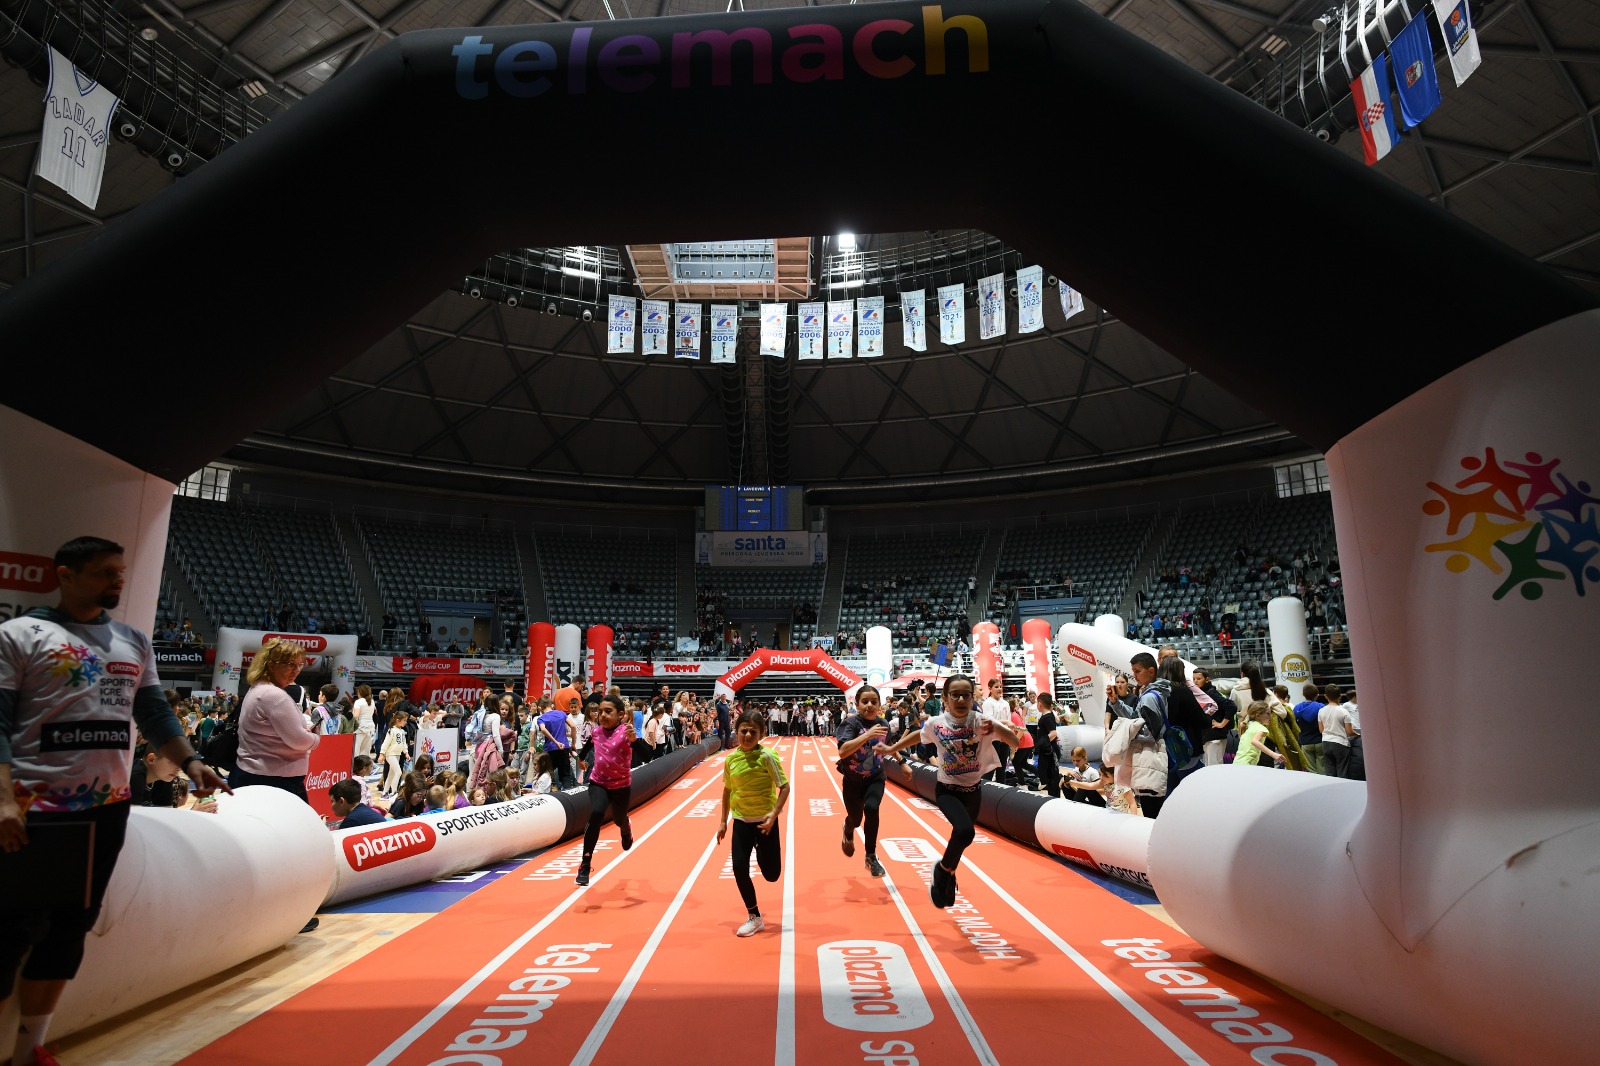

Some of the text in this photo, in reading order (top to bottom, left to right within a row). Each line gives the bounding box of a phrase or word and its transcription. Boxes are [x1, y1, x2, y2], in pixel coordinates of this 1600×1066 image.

[451, 5, 990, 99] telemach
[50, 96, 106, 147] ZADAR
[61, 127, 86, 168] 11
[734, 535, 786, 550] santa
[438, 662, 451, 670] CUP
[612, 663, 641, 672] lazma
[770, 654, 810, 665] plazma
[663, 664, 701, 673] TOMMY
[725, 657, 763, 687] plazma
[817, 659, 856, 687] plazma
[1286, 671, 1307, 679] MUP
[100, 687, 122, 696] IGRE
[52, 727, 129, 744] telemach
[352, 826, 426, 867] plazma
[436, 809, 498, 836] SPORTSKE
[493, 804, 519, 819] IGRE
[828, 946, 900, 1016] plazma
